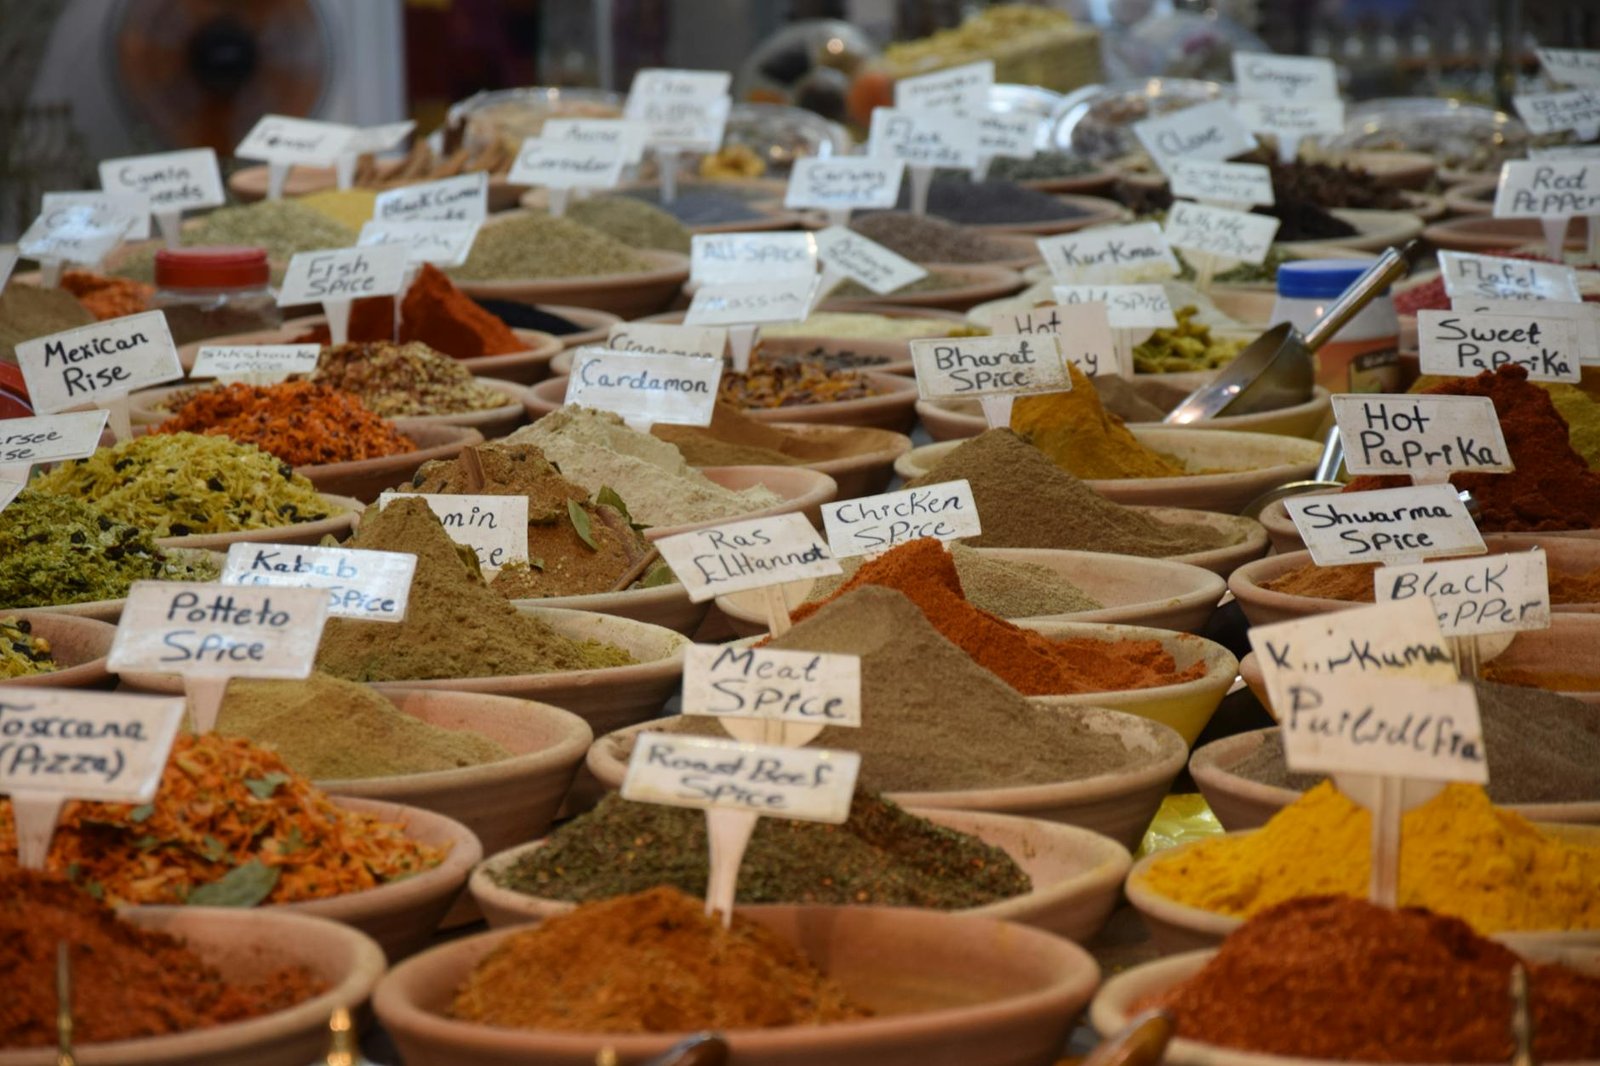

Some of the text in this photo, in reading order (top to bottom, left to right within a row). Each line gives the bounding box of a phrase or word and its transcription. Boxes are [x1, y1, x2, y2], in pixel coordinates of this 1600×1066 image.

[1533, 166, 1588, 190] Red
[1436, 318, 1541, 345] Sweet
[934, 341, 1036, 370] Bharat
[62, 364, 132, 397] Rise
[581, 360, 708, 394] Cardamon
[1363, 403, 1430, 433] Hot
[442, 506, 498, 529] min
[1303, 504, 1453, 530] Shwarma
[697, 528, 772, 551] Ras
[252, 550, 358, 578] Kabab
[167, 591, 290, 627] Potteto
[711, 646, 821, 681] Meat
[748, 756, 834, 789] Beef
